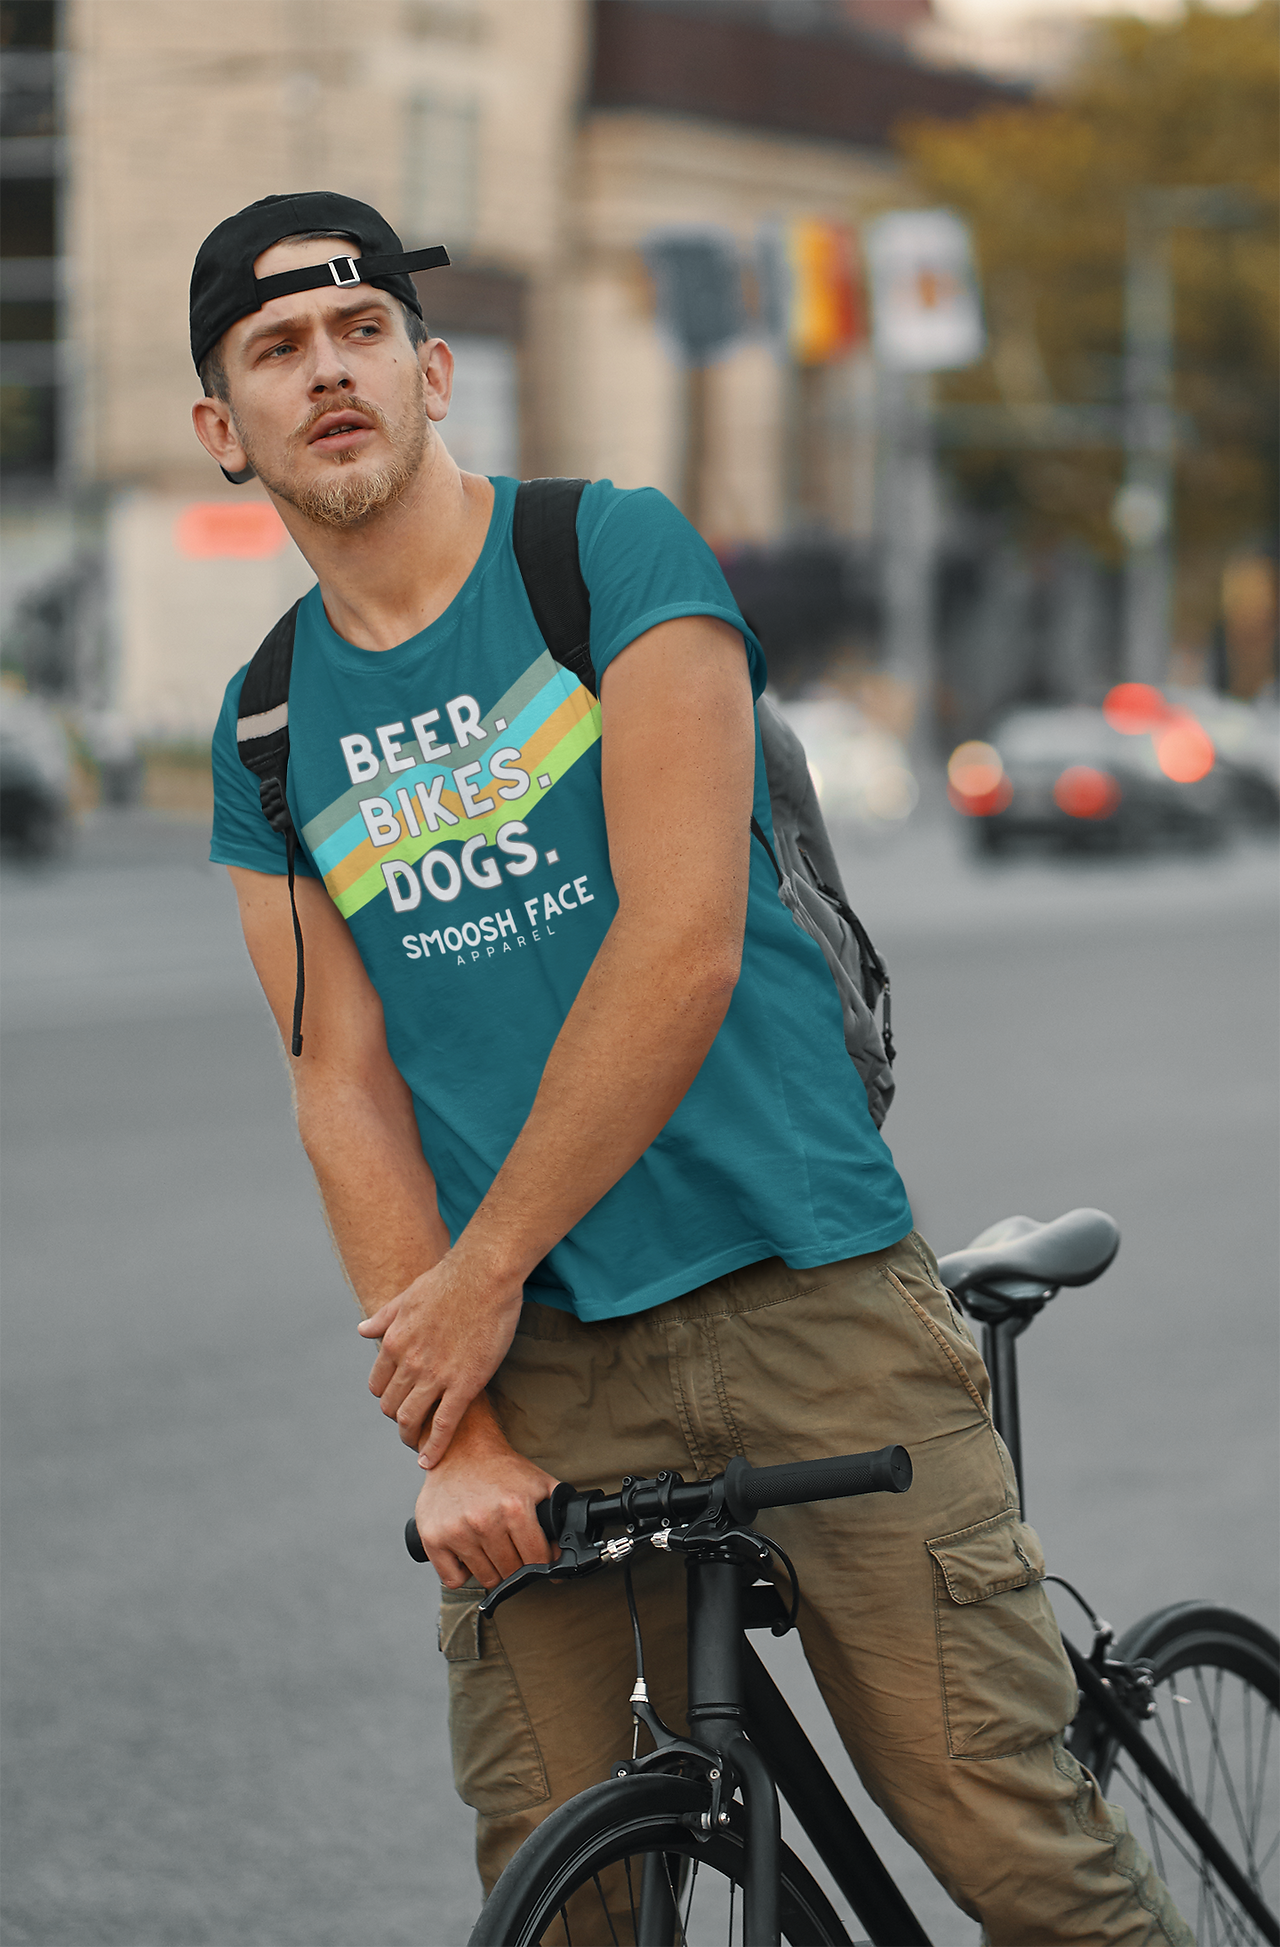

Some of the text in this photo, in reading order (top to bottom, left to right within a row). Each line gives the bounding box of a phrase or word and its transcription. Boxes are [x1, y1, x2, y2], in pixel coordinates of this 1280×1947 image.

[339, 694, 509, 785] BEER.
[358, 747, 553, 848] BIKES.
[380, 820, 560, 913] DOGS.
[402, 875, 595, 959] SMOOSH FACE
[456, 925, 556, 966] APPAREL
